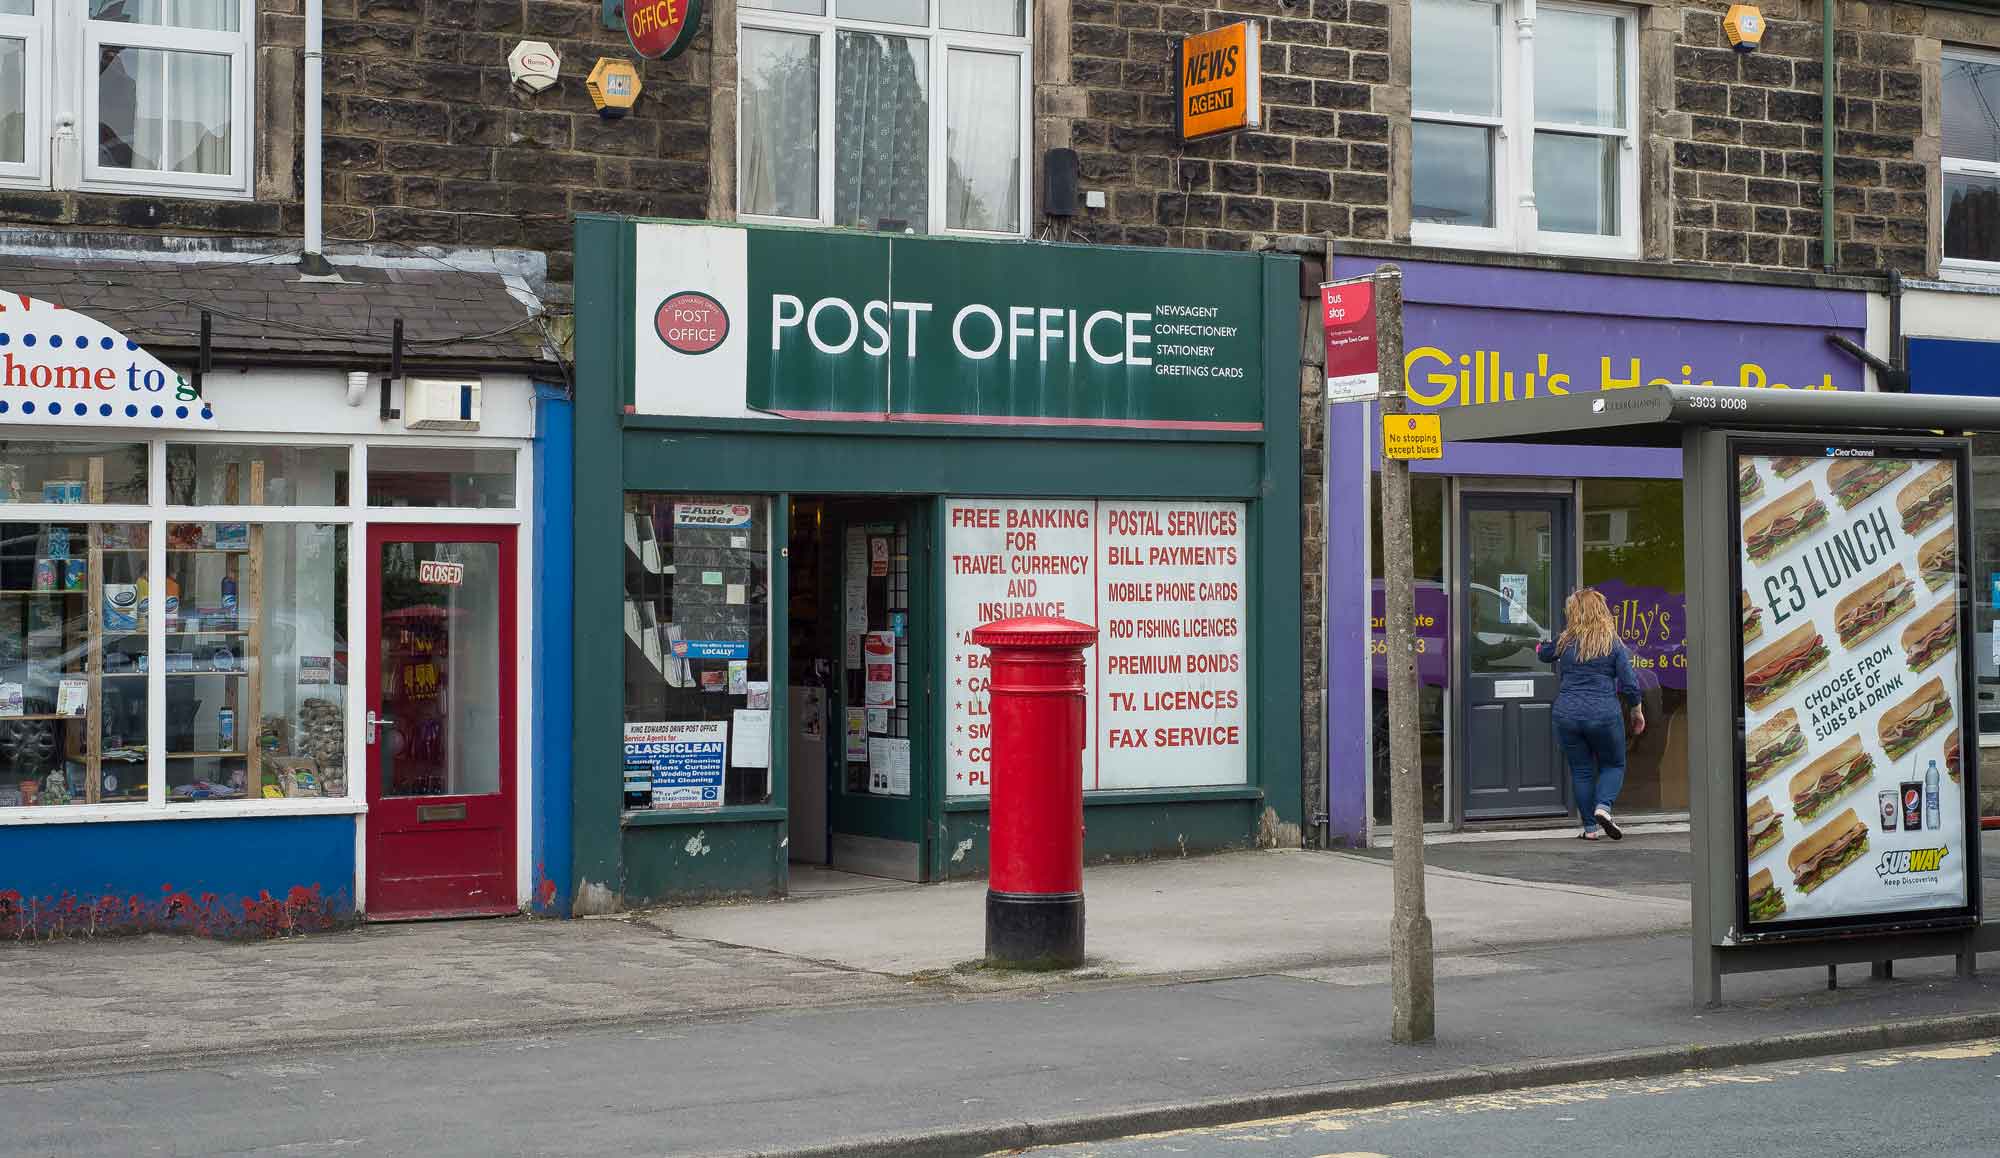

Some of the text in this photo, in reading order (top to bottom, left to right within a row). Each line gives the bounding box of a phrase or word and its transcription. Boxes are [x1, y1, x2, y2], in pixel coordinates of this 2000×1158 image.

[633, 0, 679, 38] OFFICE
[1185, 45, 1239, 88] NEWS
[1190, 89, 1232, 115] AGENT
[1327, 291, 1342, 304] bus
[674, 310, 711, 322] POST
[1155, 304, 1219, 318] NEWSAGENT
[1328, 307, 1345, 320] stop
[668, 328, 717, 342] OFFICE
[772, 294, 1152, 366] POST OFFICE
[1155, 324, 1238, 337] CONFECTIONERY
[1156, 344, 1215, 357] STATIONERY
[3, 353, 116, 391] home
[126, 361, 165, 392] to
[1155, 364, 1244, 378] GREETINGS CARDS
[1689, 396, 1747, 410] 3903 0008
[1390, 433, 1437, 444] No stopping
[1389, 445, 1439, 455] except buses
[1835, 448, 1874, 457] Clear Channel
[680, 514, 735, 524] Trader
[690, 506, 724, 515] Auto
[952, 508, 1089, 529] FREE BANKING
[1108, 510, 1237, 537] POSTAL SERVICES
[1006, 532, 1036, 551] FOR
[952, 555, 1088, 575] TRAVEL CURRENCY
[1108, 546, 1238, 566] BILL PAYMENTS
[1763, 565, 1806, 625] £3
[1802, 506, 1896, 599] LUNCH
[422, 563, 462, 584] CLOSED
[1007, 579, 1037, 598] AND
[1108, 582, 1238, 602] MOBILE PHONE CARDS
[978, 602, 1065, 622] INSURANCE
[1109, 618, 1238, 639] ROD FISHING LICENCES
[1612, 599, 1671, 647] illy's
[1108, 654, 1239, 675] PREMIUM BONDS
[1659, 654, 1668, 668] &
[1804, 644, 1893, 710] CHOOSE FROM
[1109, 691, 1239, 712] TV. LICENCES
[1812, 669, 1881, 727] A RANGE OF
[1815, 673, 1904, 741] SUBS & A DRINK
[644, 725, 669, 733] EDWARDS
[669, 725, 685, 733] DRIVE
[685, 724, 700, 733] POST
[700, 724, 718, 732] OFFICE
[1109, 726, 1239, 748] FAX SERVICE
[624, 743, 722, 754] CLASSICLEAN
[646, 735, 668, 743] Agents
[660, 770, 692, 778] Wedding
[1876, 845, 1949, 877] SUBWAY
[1883, 875, 1938, 887] Keep Discovering
